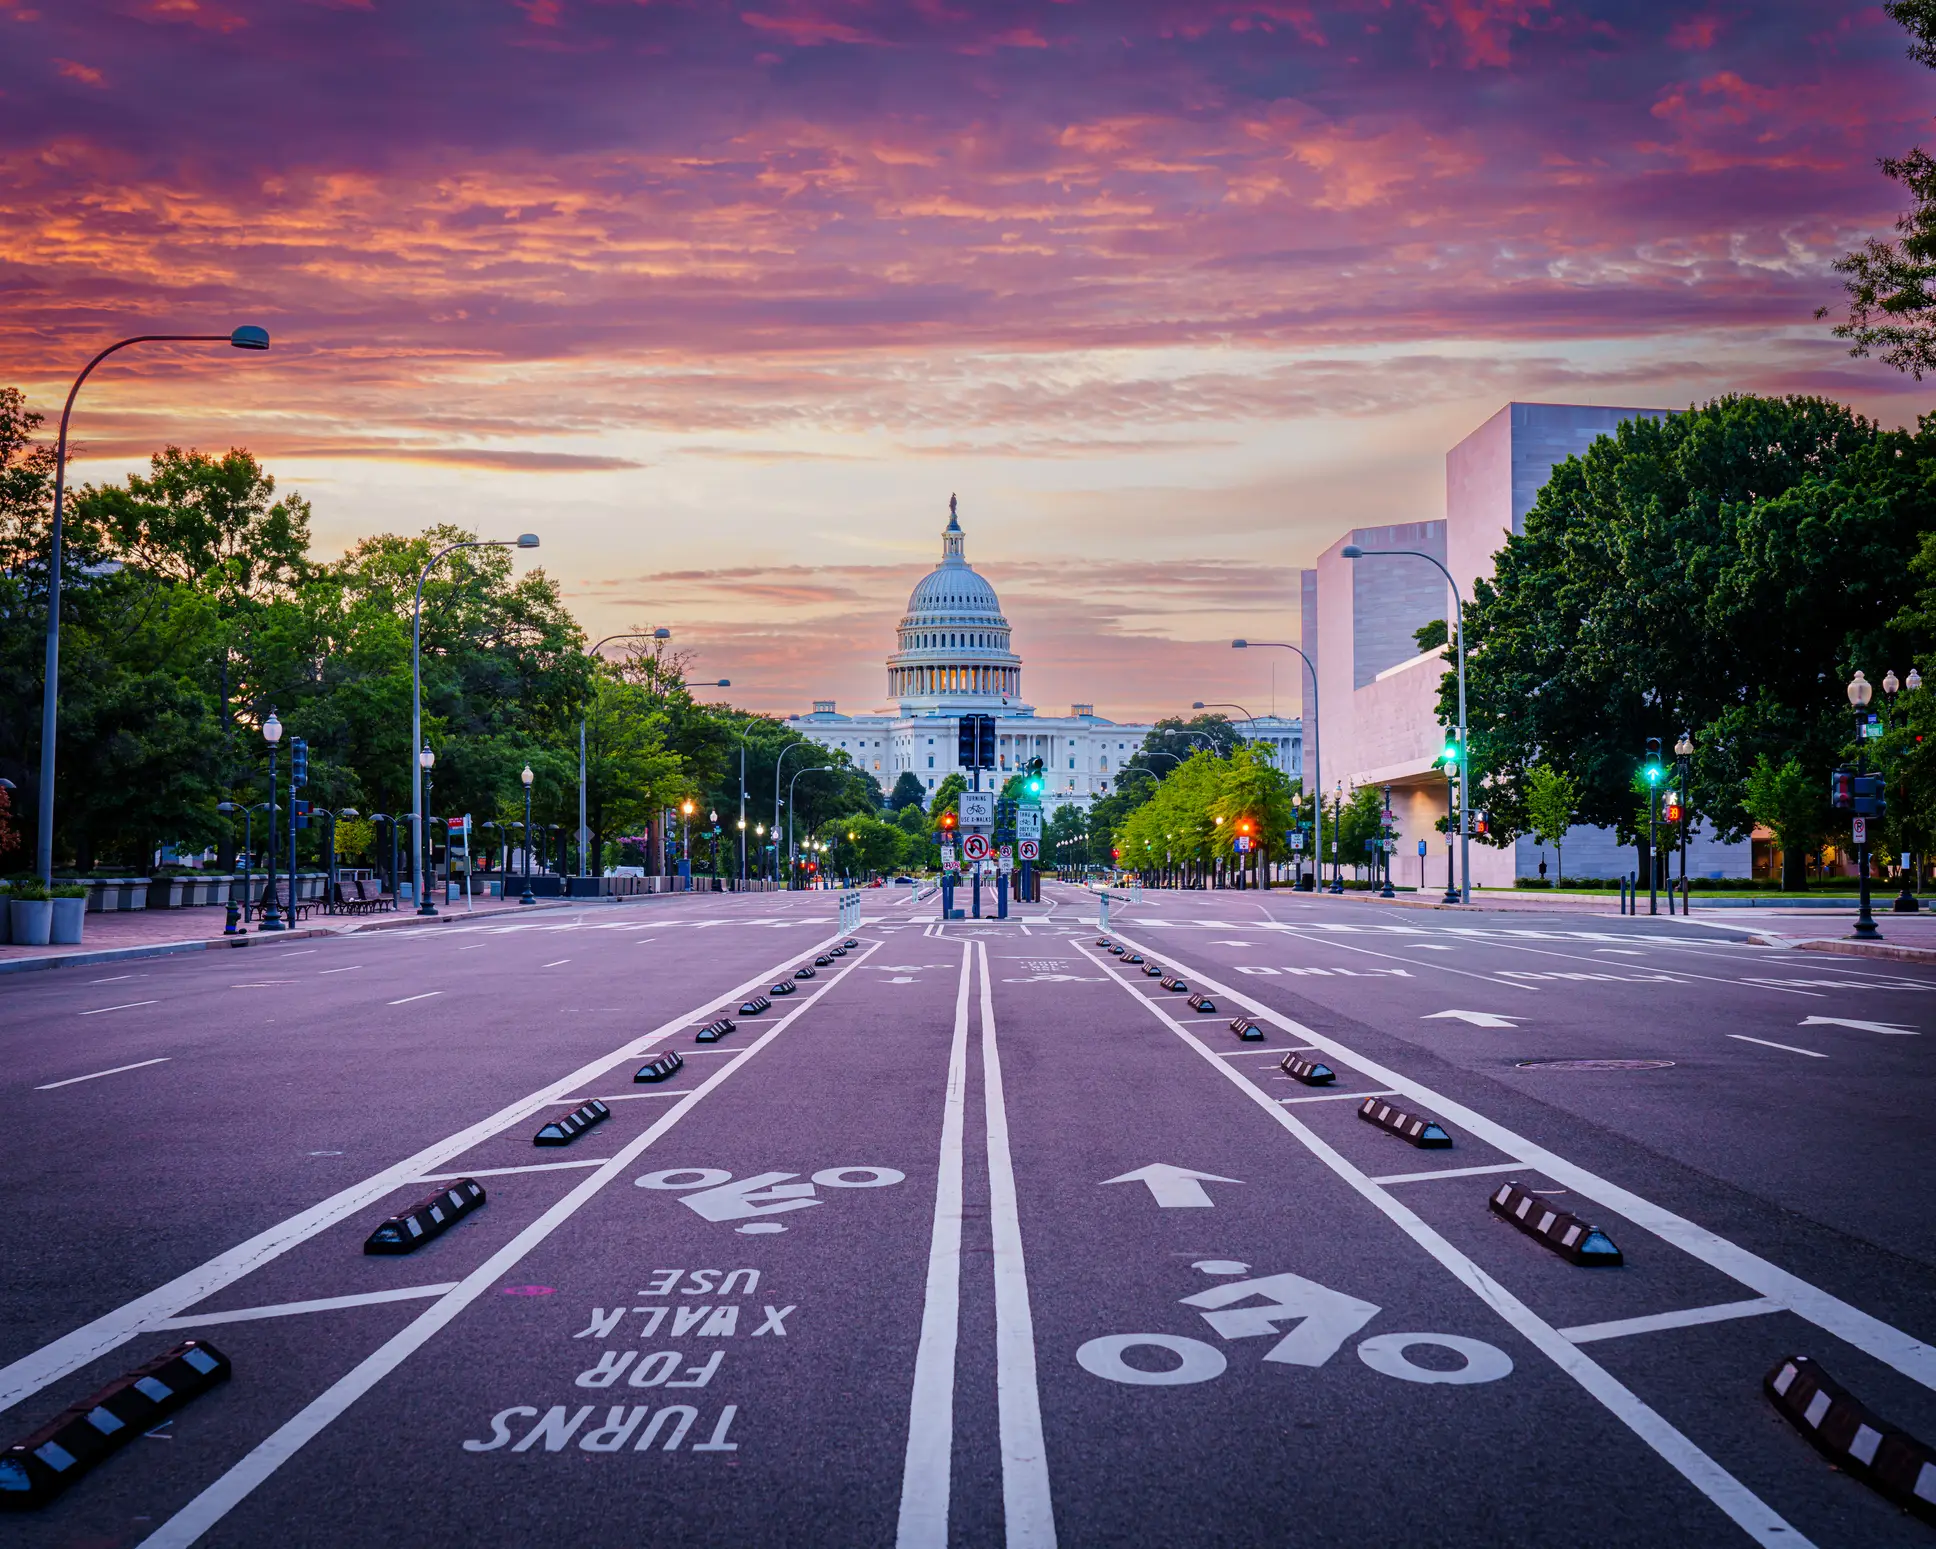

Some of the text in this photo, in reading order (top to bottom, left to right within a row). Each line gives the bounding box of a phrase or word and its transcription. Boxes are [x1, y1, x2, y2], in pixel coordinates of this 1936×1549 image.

[1669, 807, 1678, 819] 39
[1233, 966, 1417, 978] ONLY
[1493, 971, 1693, 984] ONLY
[637, 1268, 761, 1296] USE
[572, 1305, 797, 1339] X WALK
[574, 1350, 726, 1388] FOR
[462, 1404, 739, 1452] TURNS
